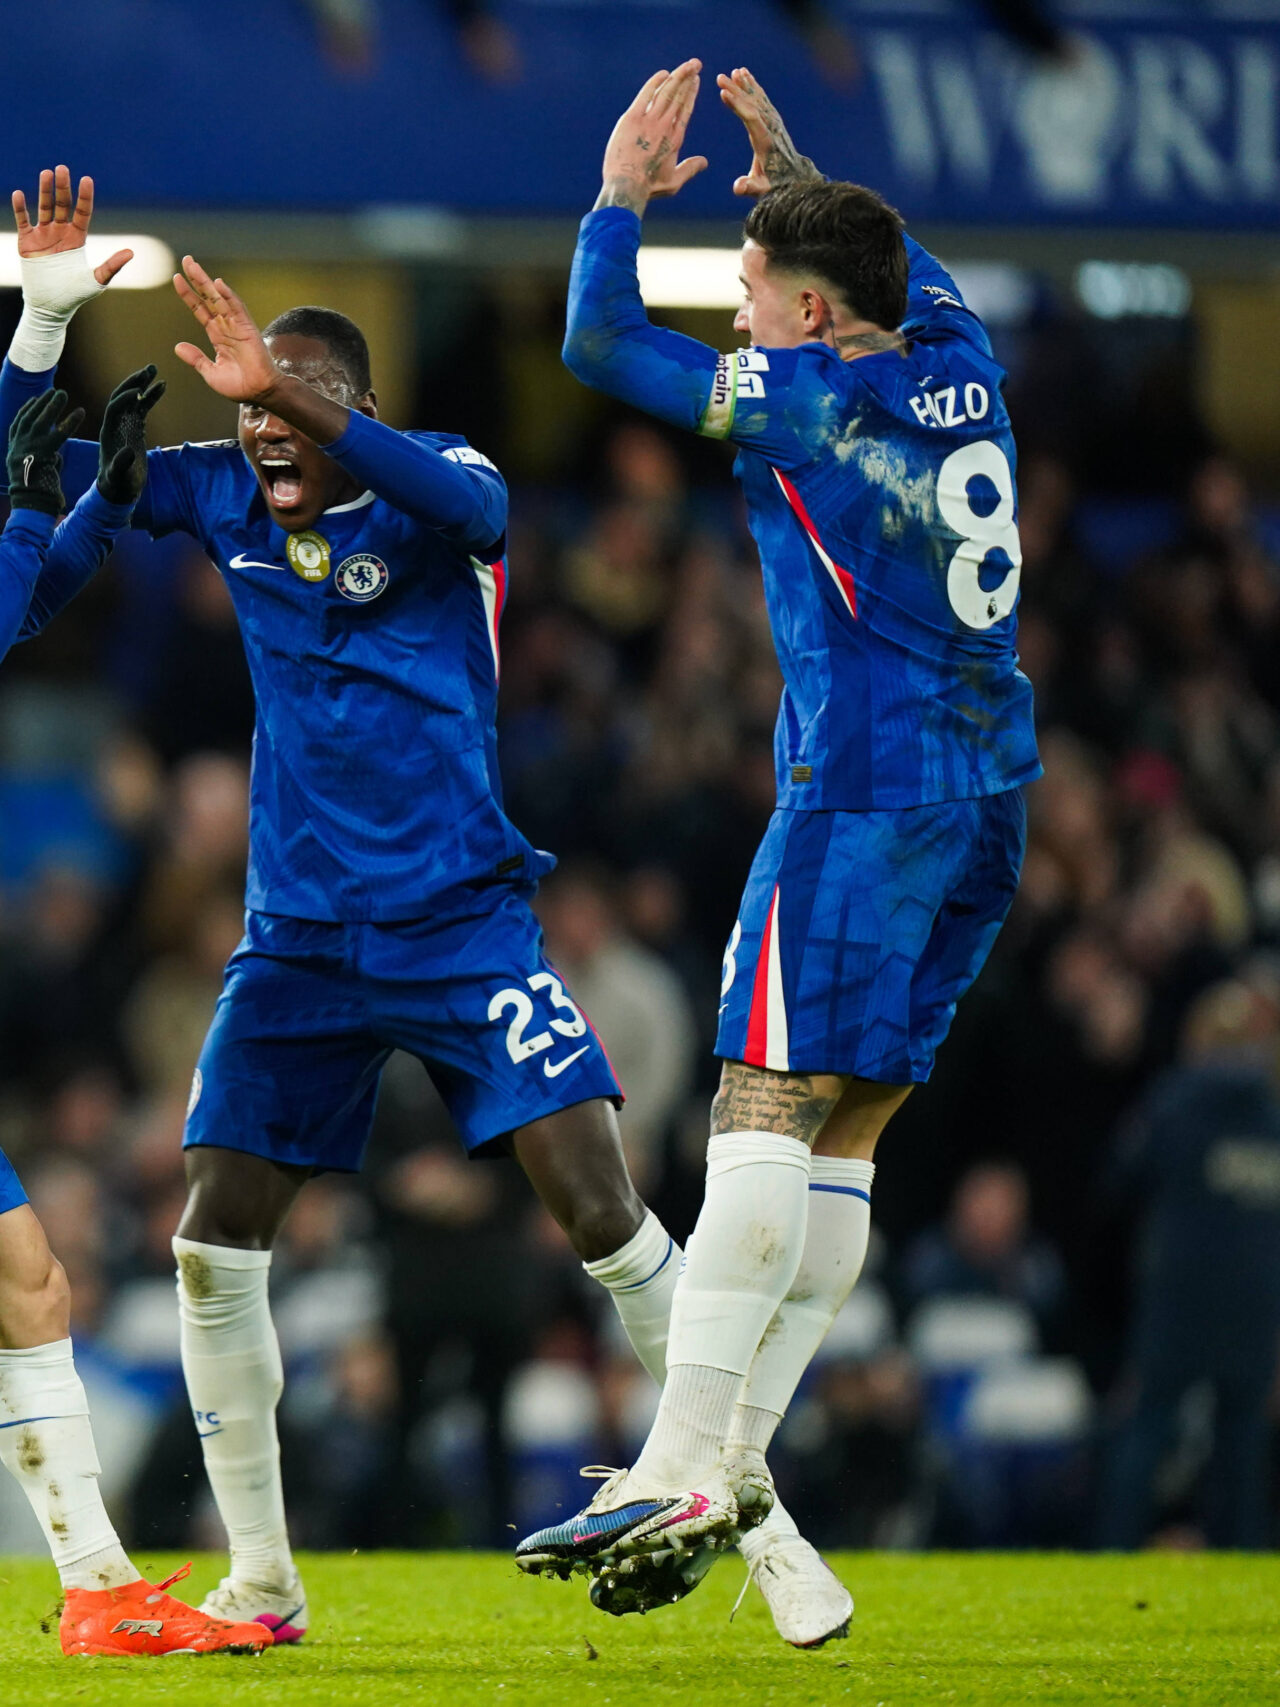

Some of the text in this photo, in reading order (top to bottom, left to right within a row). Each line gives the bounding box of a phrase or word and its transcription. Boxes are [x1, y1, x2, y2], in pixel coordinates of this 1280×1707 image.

[304, 569, 323, 577] FIFA
[937, 440, 1022, 629] 8
[487, 972, 587, 1064] 23
